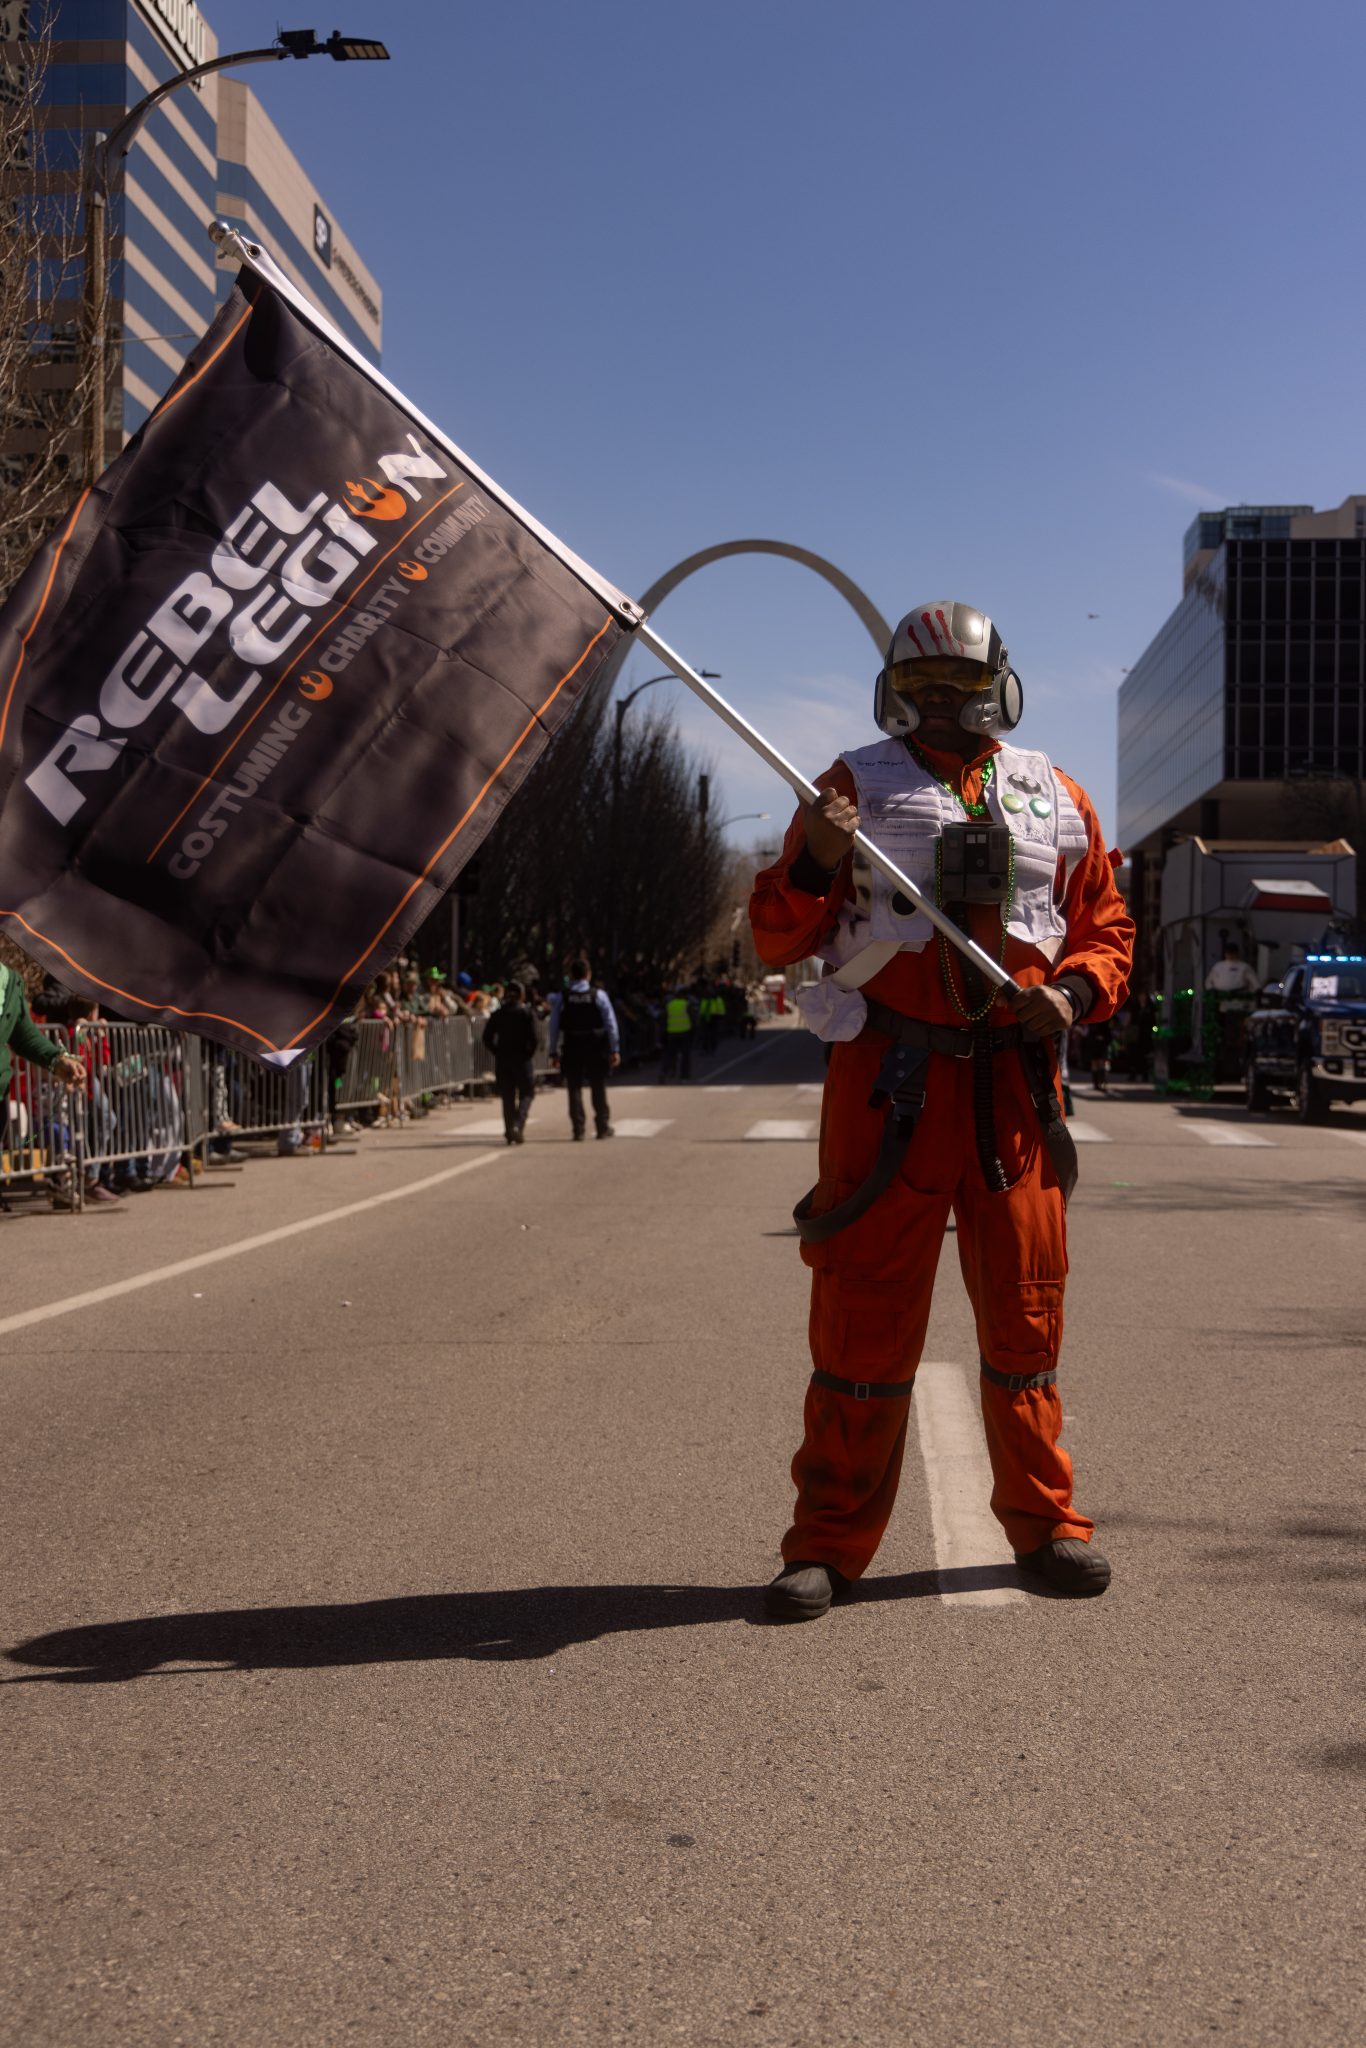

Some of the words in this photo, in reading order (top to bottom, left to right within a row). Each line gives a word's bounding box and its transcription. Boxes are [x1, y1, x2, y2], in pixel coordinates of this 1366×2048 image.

[25, 481, 329, 827] REBEL
[167, 700, 313, 880] COSTUMING
[319, 574, 407, 673] CHARITY
[413, 494, 491, 565] COMMUNITY
[171, 433, 448, 735] LEGION
